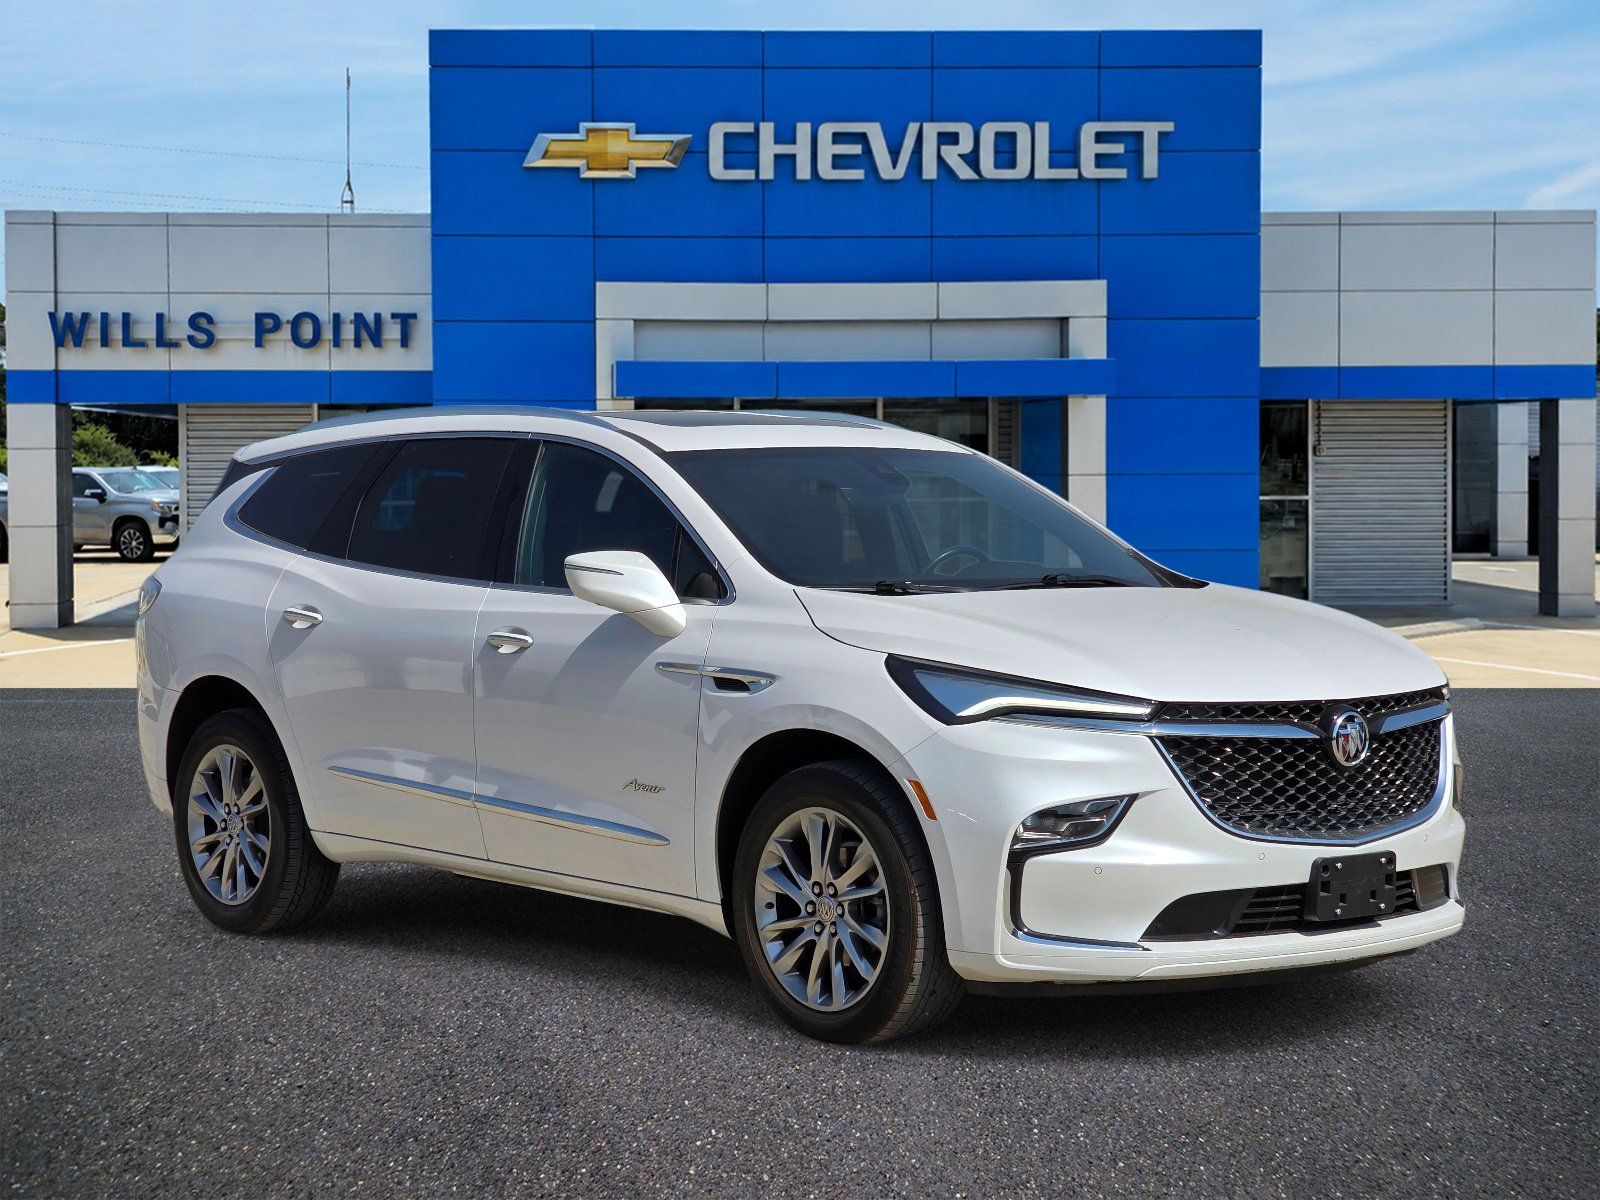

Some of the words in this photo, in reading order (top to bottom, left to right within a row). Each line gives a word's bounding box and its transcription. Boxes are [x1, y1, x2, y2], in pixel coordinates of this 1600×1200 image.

[708, 120, 1175, 181] CHEVROLET
[48, 311, 217, 350] WILLS
[253, 312, 418, 350] POINT
